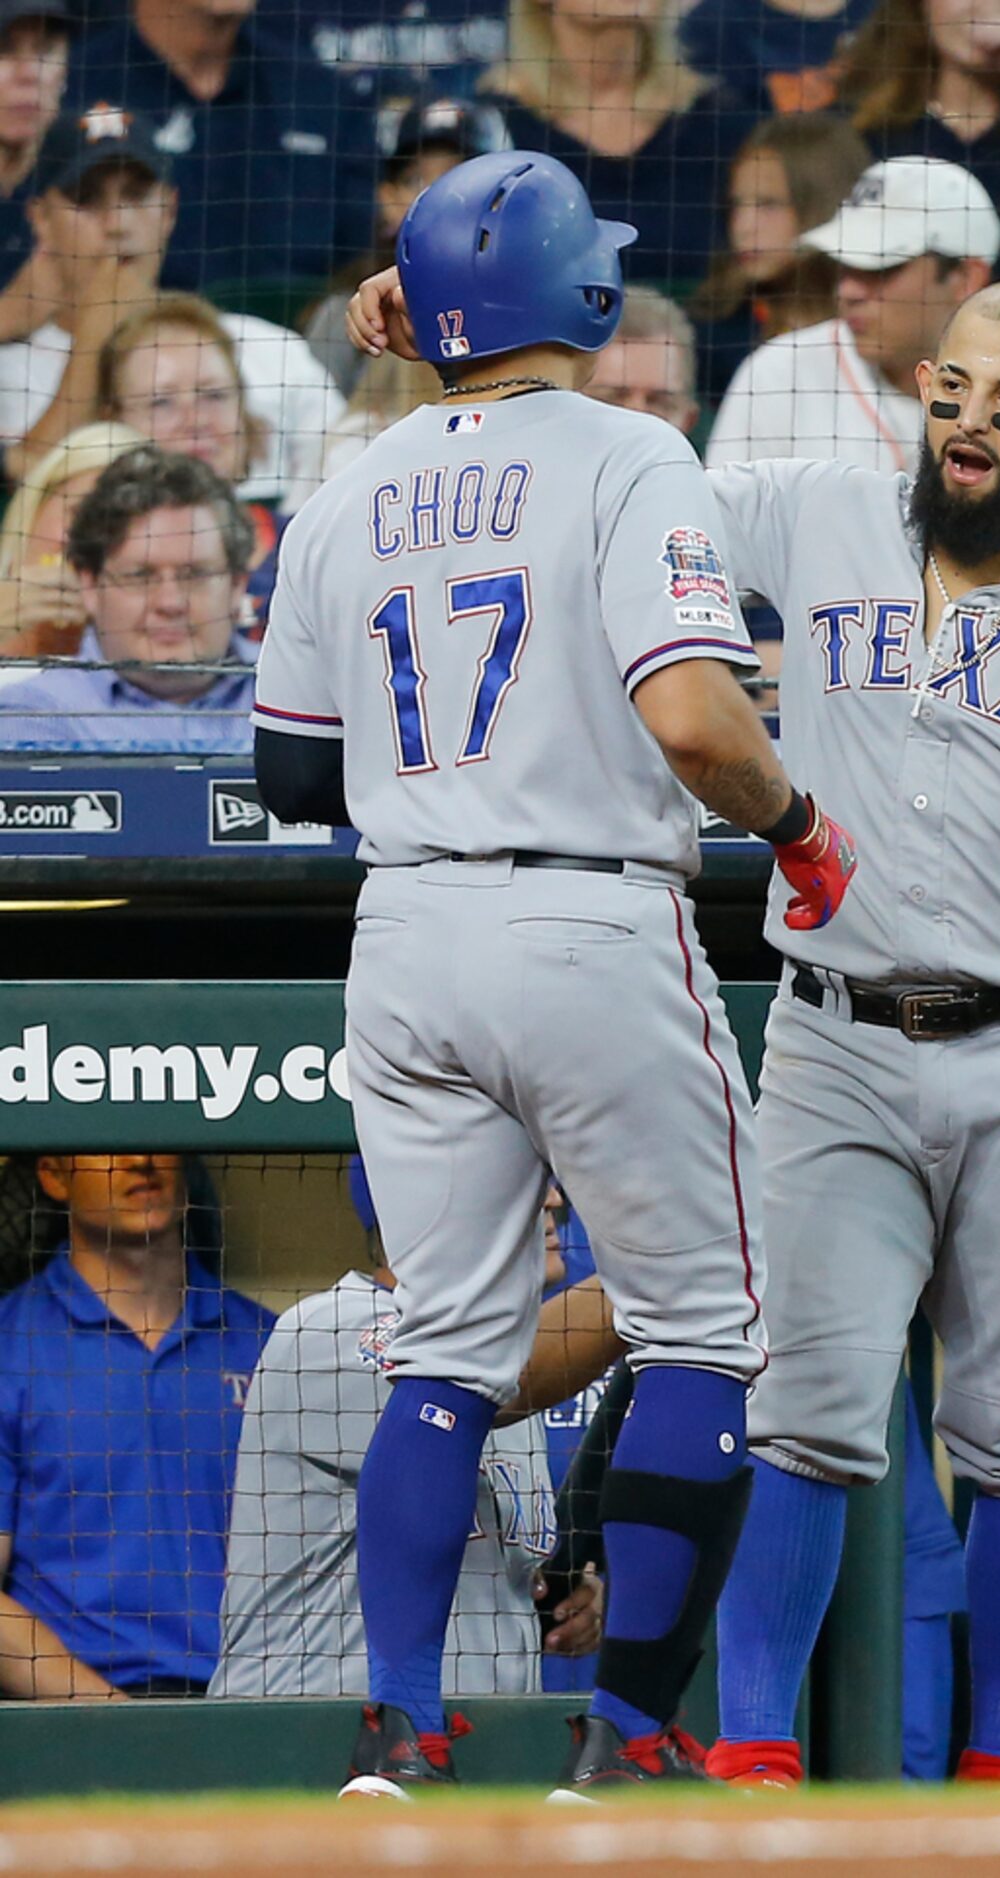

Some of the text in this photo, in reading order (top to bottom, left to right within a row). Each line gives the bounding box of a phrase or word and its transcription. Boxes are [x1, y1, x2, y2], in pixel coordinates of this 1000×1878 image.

[437, 309, 464, 337] 17
[368, 459, 534, 562] CHOO
[366, 566, 533, 777] 17
